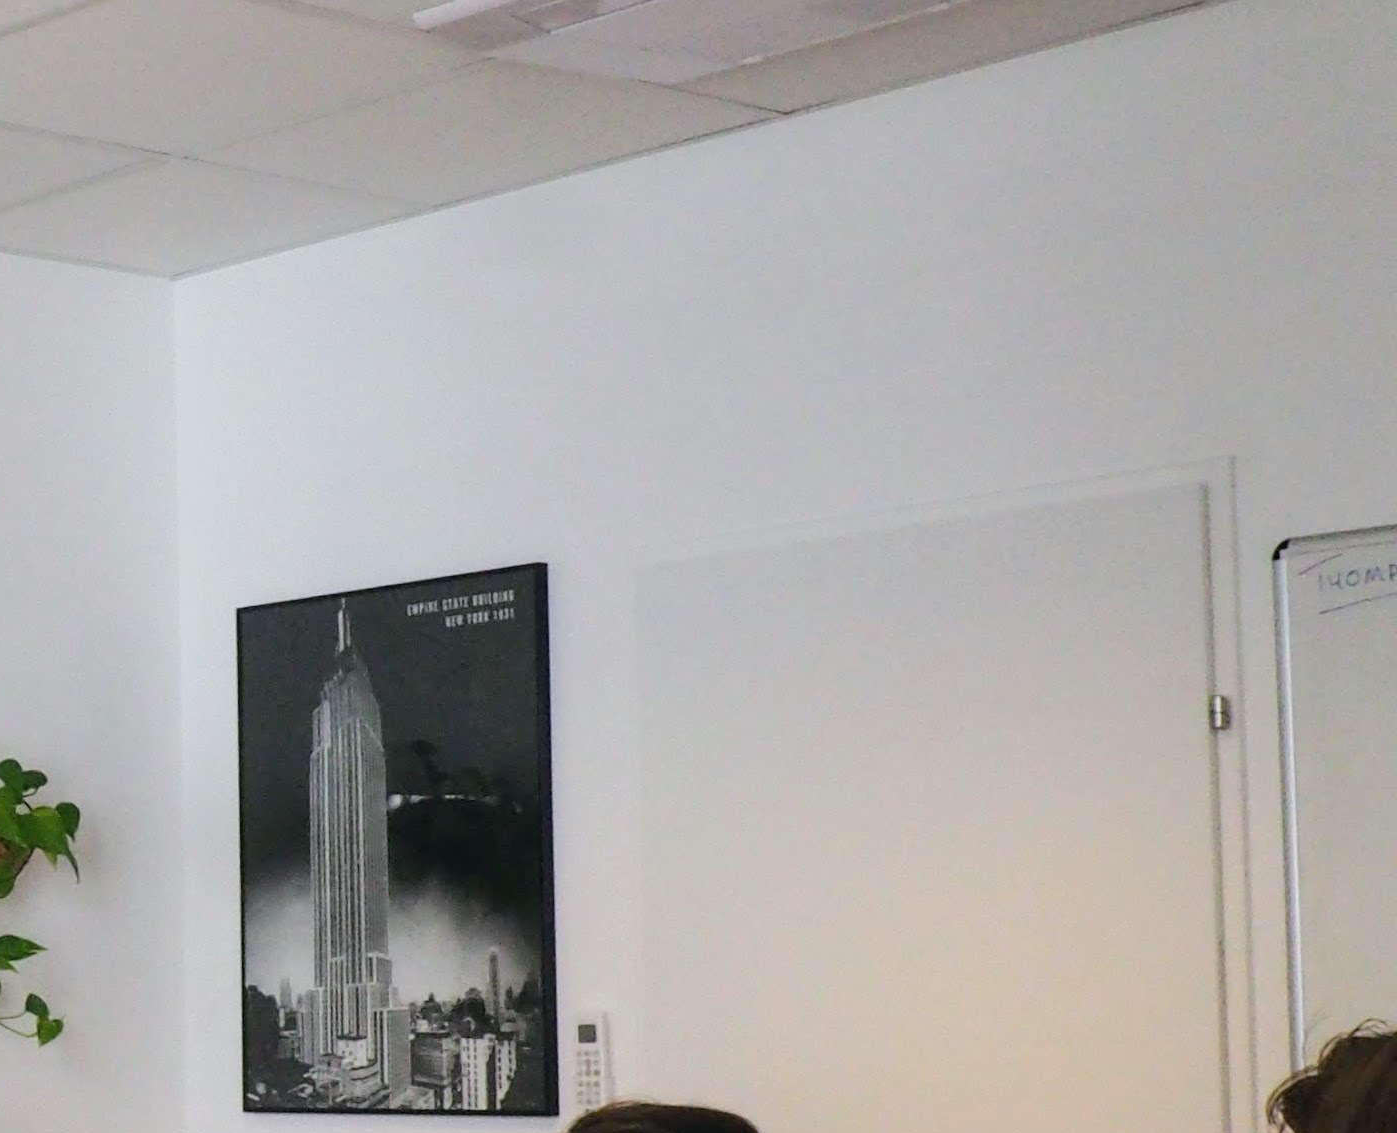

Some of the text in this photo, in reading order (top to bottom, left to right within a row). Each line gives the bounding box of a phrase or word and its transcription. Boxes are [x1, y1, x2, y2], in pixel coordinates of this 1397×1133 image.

[406, 589, 515, 617] EMPIRE STATE BUILDING
[445, 614, 464, 628] NEW
[467, 610, 490, 625] YORK
